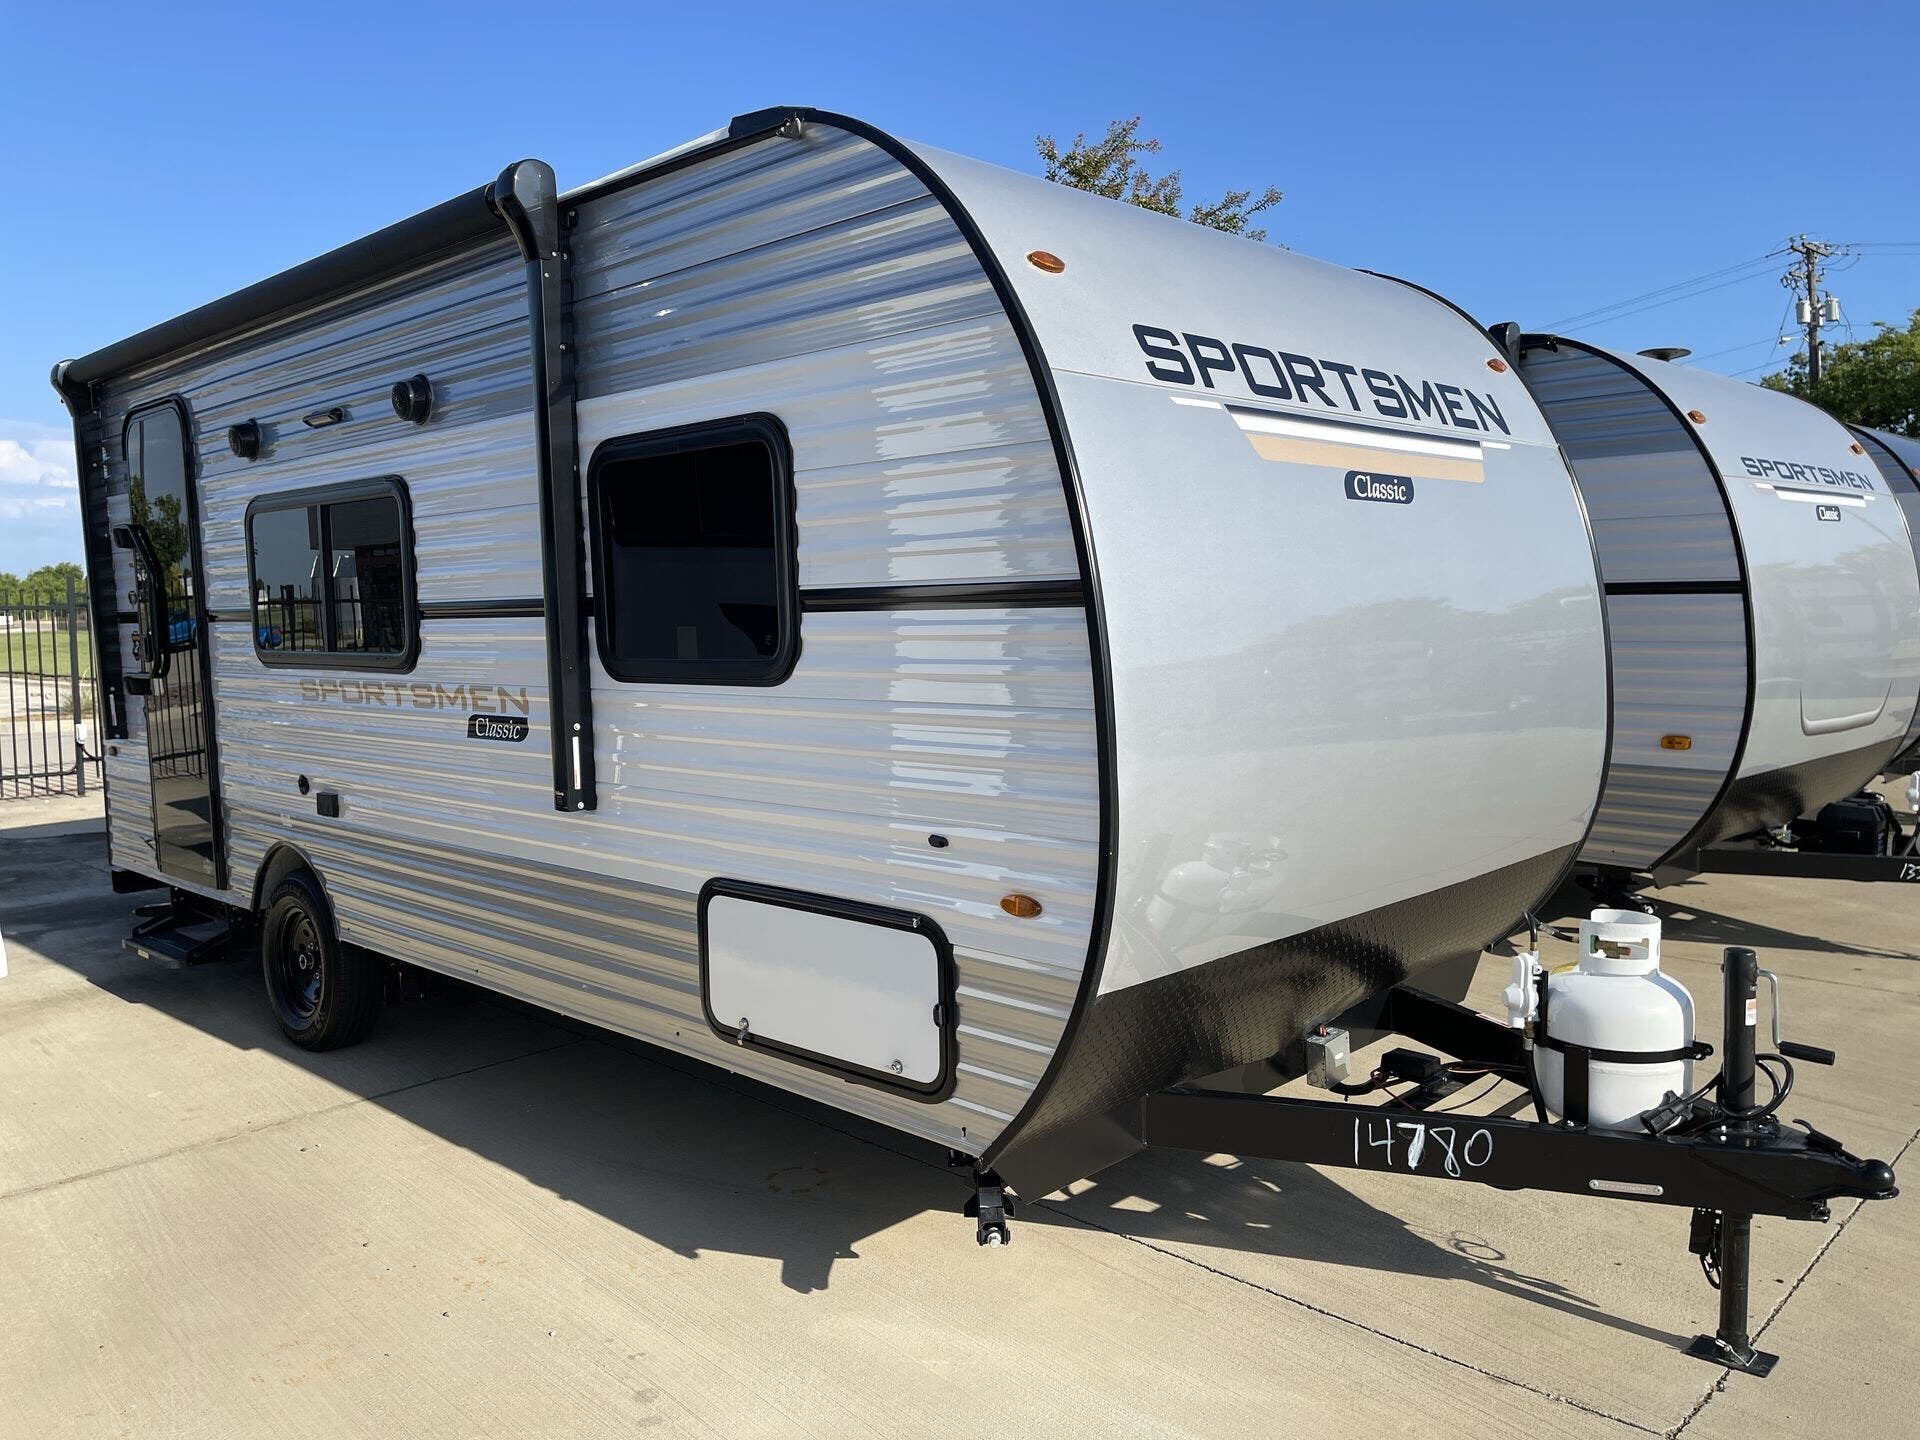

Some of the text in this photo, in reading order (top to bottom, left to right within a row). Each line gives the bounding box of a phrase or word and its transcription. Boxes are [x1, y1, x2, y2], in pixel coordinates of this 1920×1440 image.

[1132, 324, 1511, 435] SPORTSMEN
[1353, 475, 1407, 502] Classic
[1740, 456, 1875, 491] SPORTSMEN
[1818, 506, 1839, 521] Classic
[299, 678, 530, 714] SPORTSMEN
[474, 717, 521, 740] Classic
[1354, 1116, 1493, 1178] 14780
